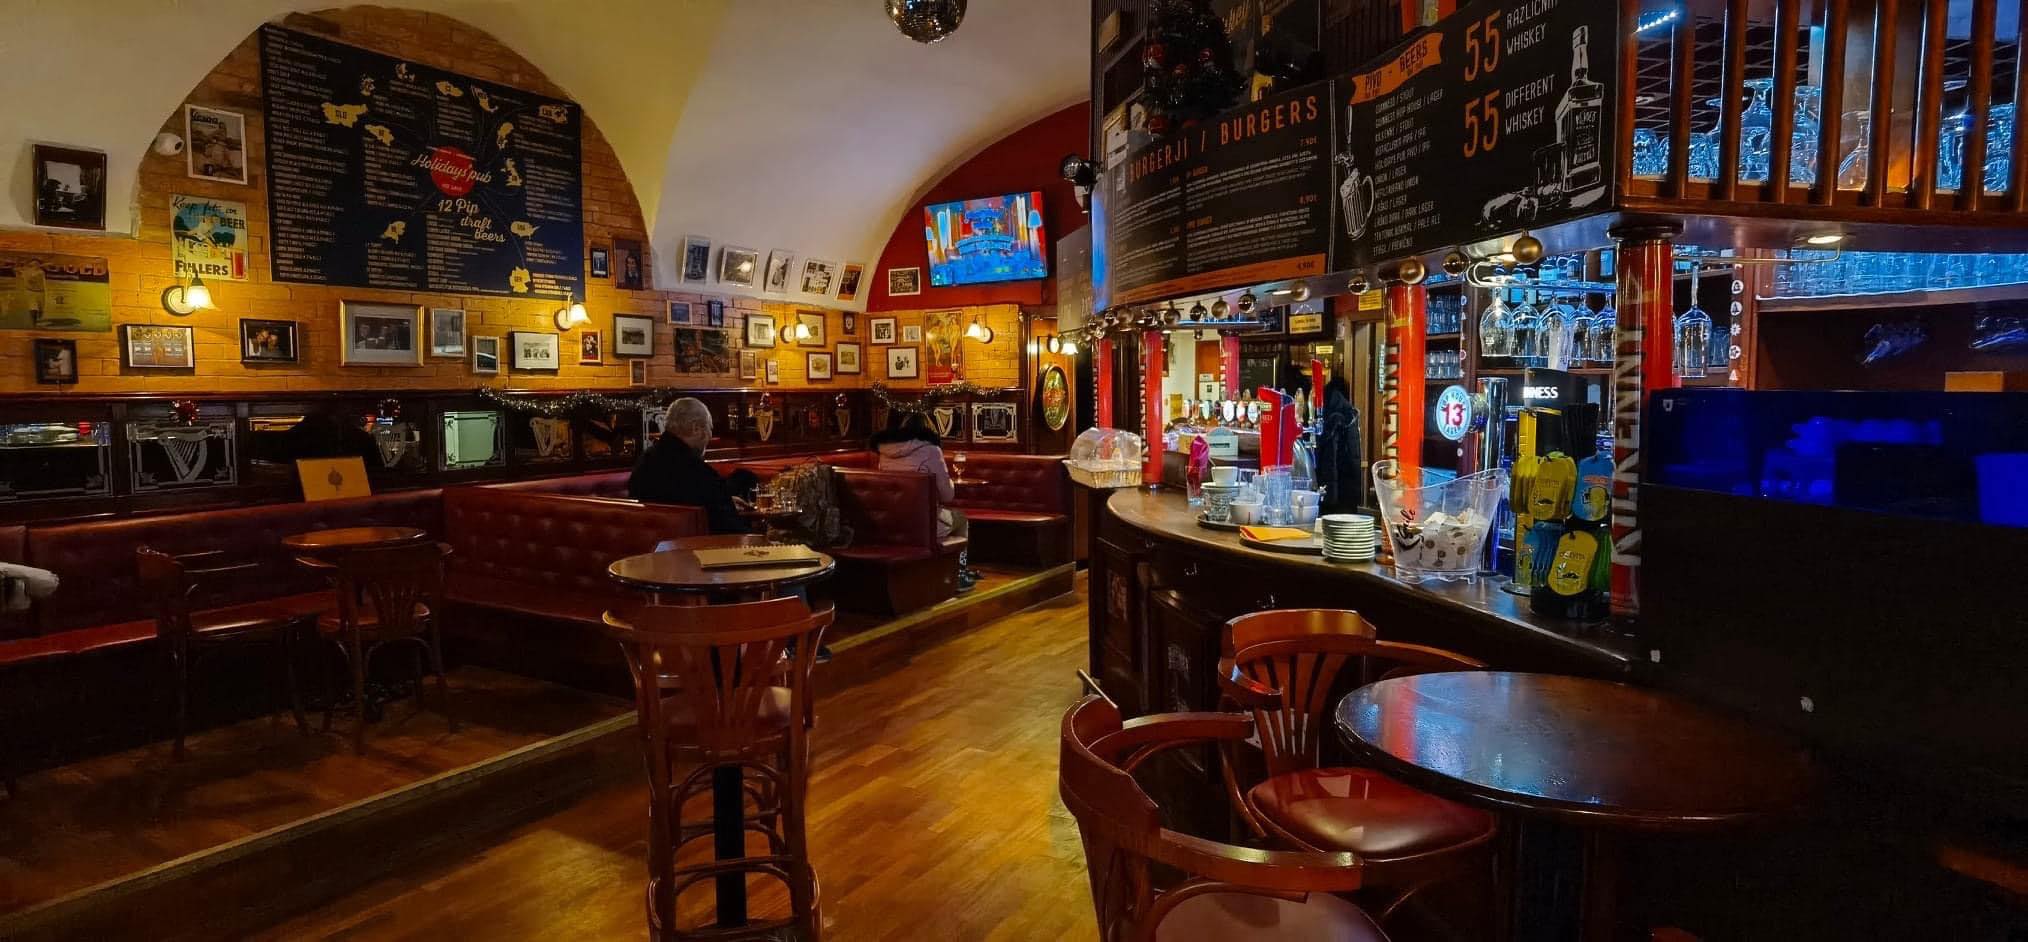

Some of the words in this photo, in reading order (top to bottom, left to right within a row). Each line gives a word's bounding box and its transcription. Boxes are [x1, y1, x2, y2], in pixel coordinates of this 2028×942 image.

[1400, 39, 1428, 73] BEERS
[1464, 8, 1502, 82] 55
[1506, 23, 1547, 57] WHISKEY
[1219, 94, 1319, 147] BURGERS
[1463, 89, 1501, 159] 55
[1505, 74, 1556, 110] DIFFERENT
[1505, 106, 1545, 136] WHISKEY
[219, 217, 245, 230] BEER
[438, 199, 453, 212] 12
[455, 198, 480, 217] Pip
[460, 216, 493, 231] draft
[474, 228, 506, 243] beers
[1440, 402, 1466, 427] 13
[1610, 324, 1642, 566] KILKENNY
